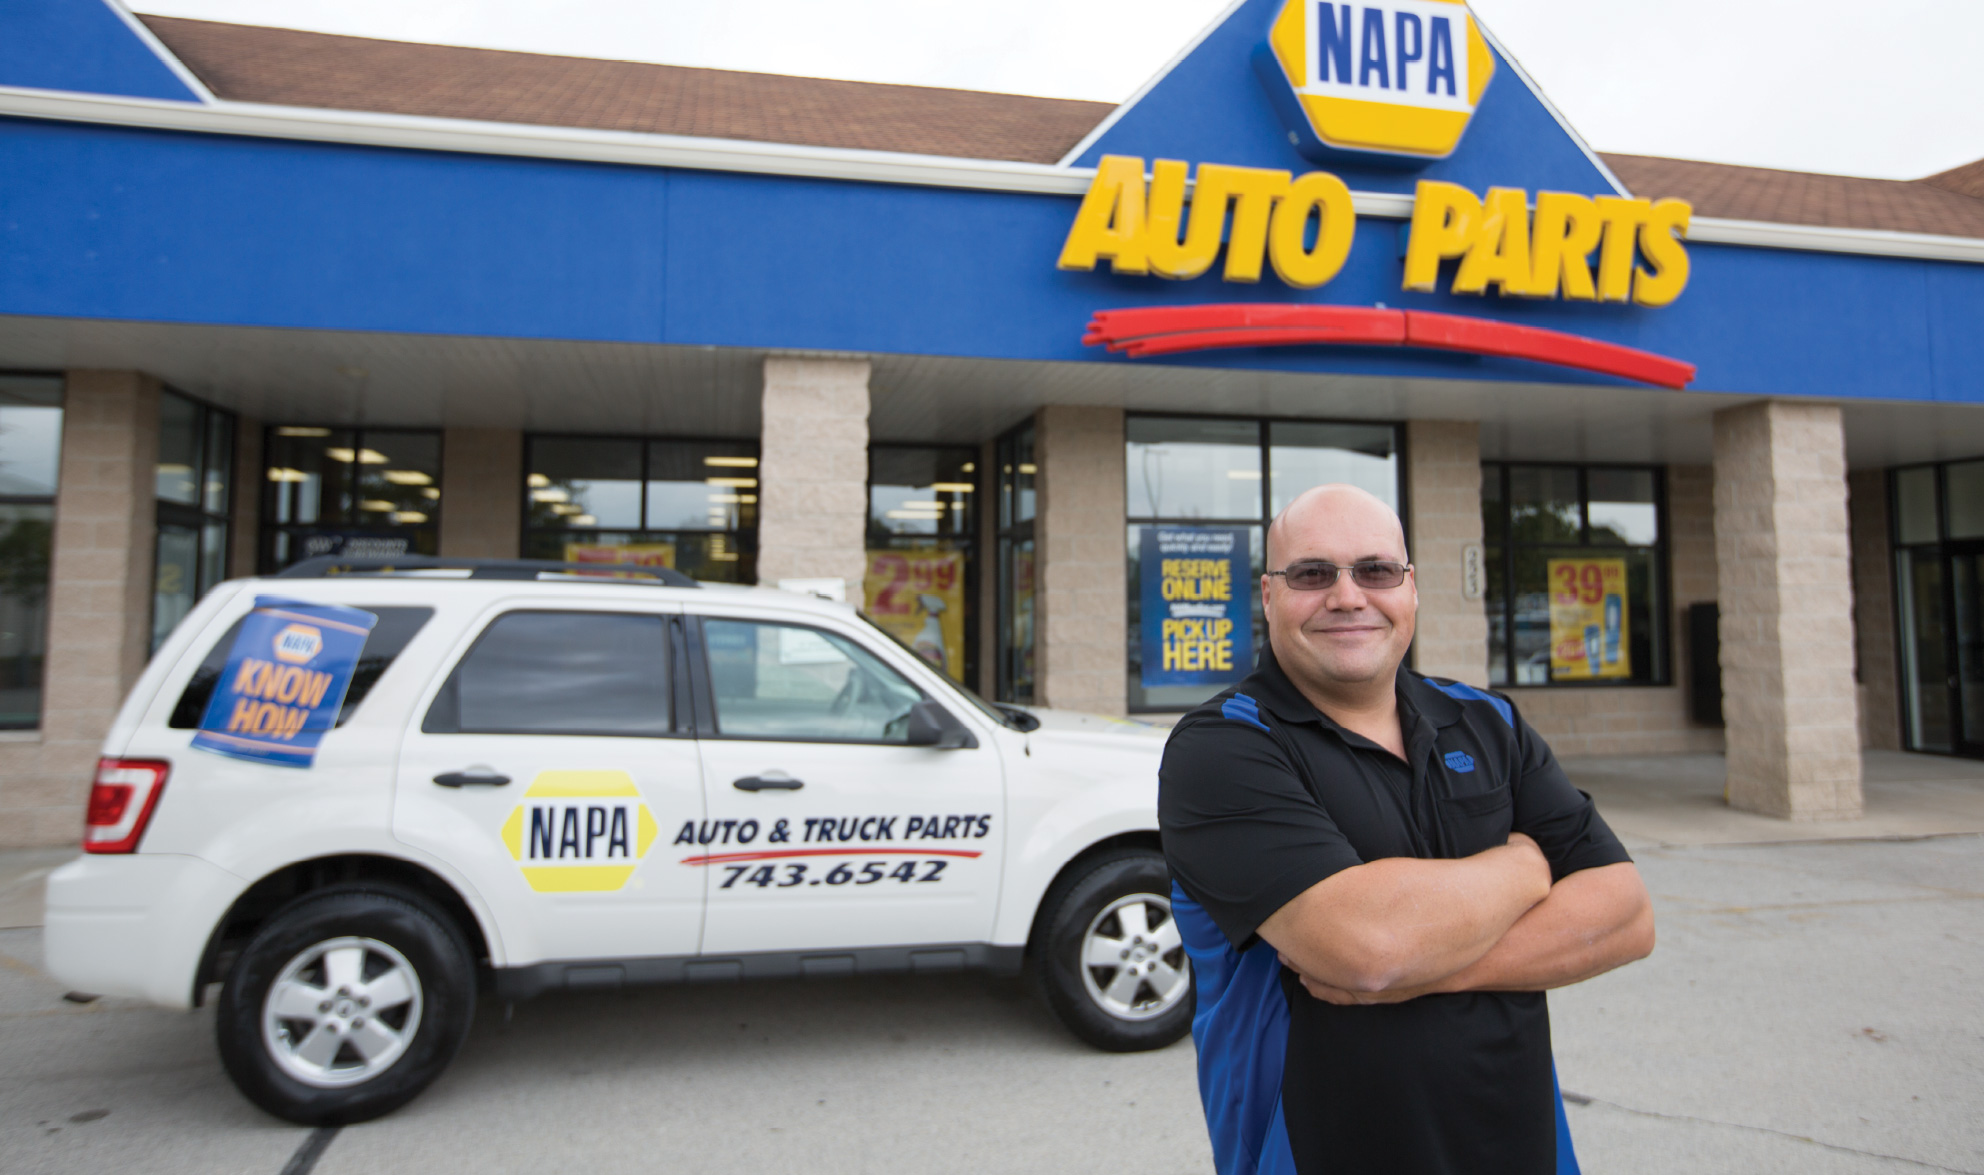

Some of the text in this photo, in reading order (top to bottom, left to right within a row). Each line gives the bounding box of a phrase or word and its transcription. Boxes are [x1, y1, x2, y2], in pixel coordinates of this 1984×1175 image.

[1317, 1, 1458, 97] NAPA
[1057, 154, 1692, 307] AUTO PARTS
[1161, 559, 1232, 578] RESERVE
[1161, 577, 1233, 601] ONLINE
[282, 632, 315, 653] NAPA
[1162, 618, 1233, 640] PICK UP
[1162, 640, 1234, 671] HERE
[232, 656, 334, 710] KNOW
[228, 697, 311, 741] HOW
[530, 806, 629, 859] NAPA
[674, 814, 992, 845] AUTO & TRUCK PARTS
[719, 860, 948, 889] 743.6542
